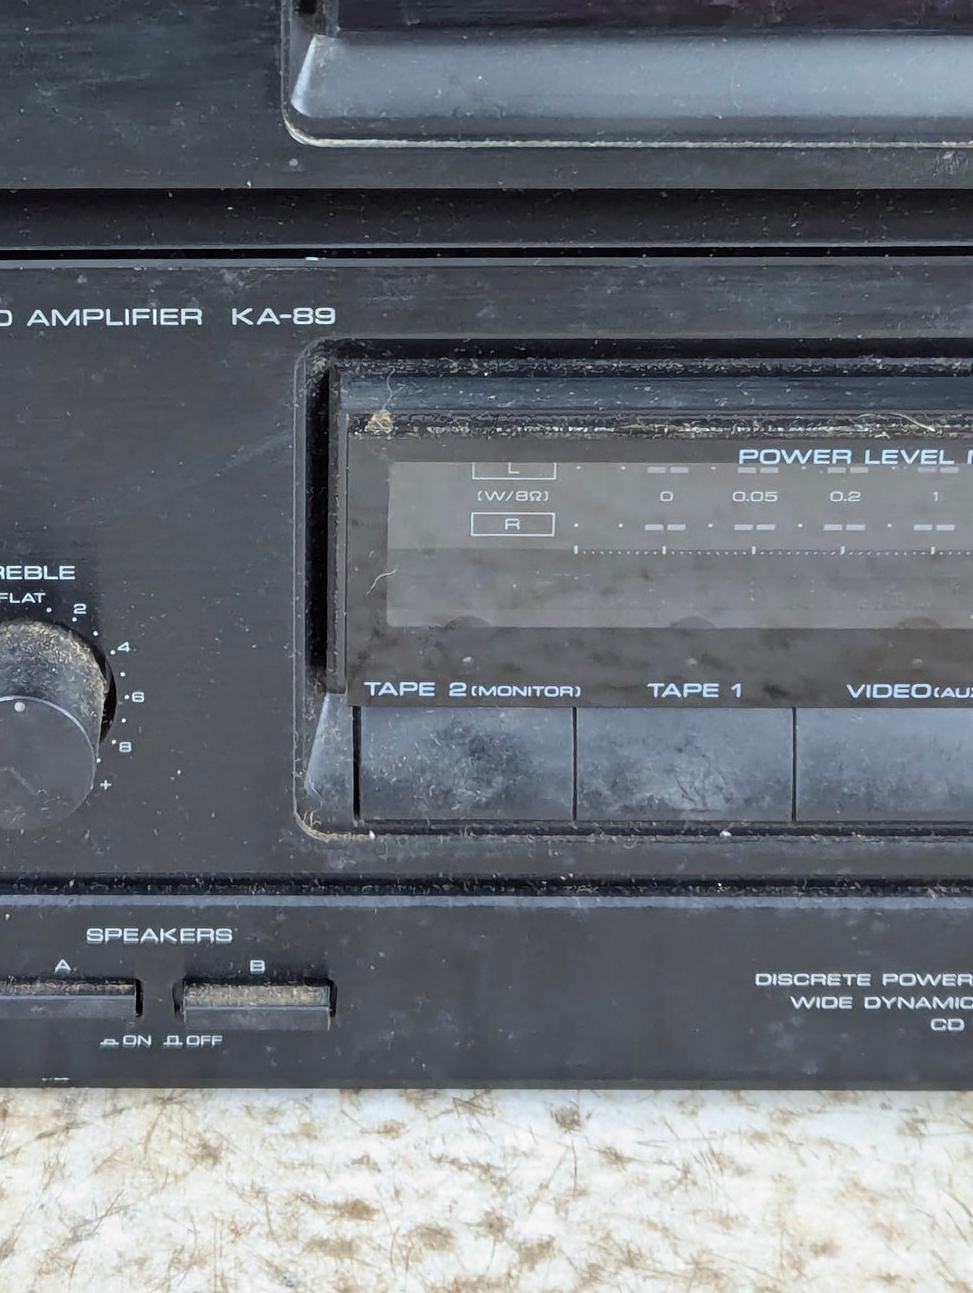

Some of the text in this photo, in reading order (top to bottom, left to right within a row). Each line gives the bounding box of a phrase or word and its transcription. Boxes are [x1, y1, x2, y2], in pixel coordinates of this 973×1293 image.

[26, 308, 203, 327] AMPLIFIER
[231, 307, 336, 326] KA-89
[738, 448, 852, 465] POWER
[864, 449, 955, 465] LEVEL
[507, 462, 521, 475] L
[659, 490, 674, 502] 0
[732, 491, 778, 502] 0.05
[830, 490, 861, 502] 0.2
[932, 491, 939, 502] 1
[504, 518, 521, 530] R
[73, 603, 87, 615] 2
[117, 641, 131, 653] 4
[363, 681, 436, 697] TAPE
[647, 682, 742, 698] TAPE 1
[131, 691, 145, 703] 6
[118, 741, 132, 753] 8
[86, 927, 233, 943] SPEAKERS
[54, 959, 72, 972] A
[249, 959, 266, 972] B
[755, 973, 973, 987] DISCRETE POWER
[790, 996, 973, 1010] WIDE DYNAMIC
[930, 1018, 965, 1032] CD
[122, 1034, 152, 1046] ON
[186, 1035, 223, 1046] OFF
